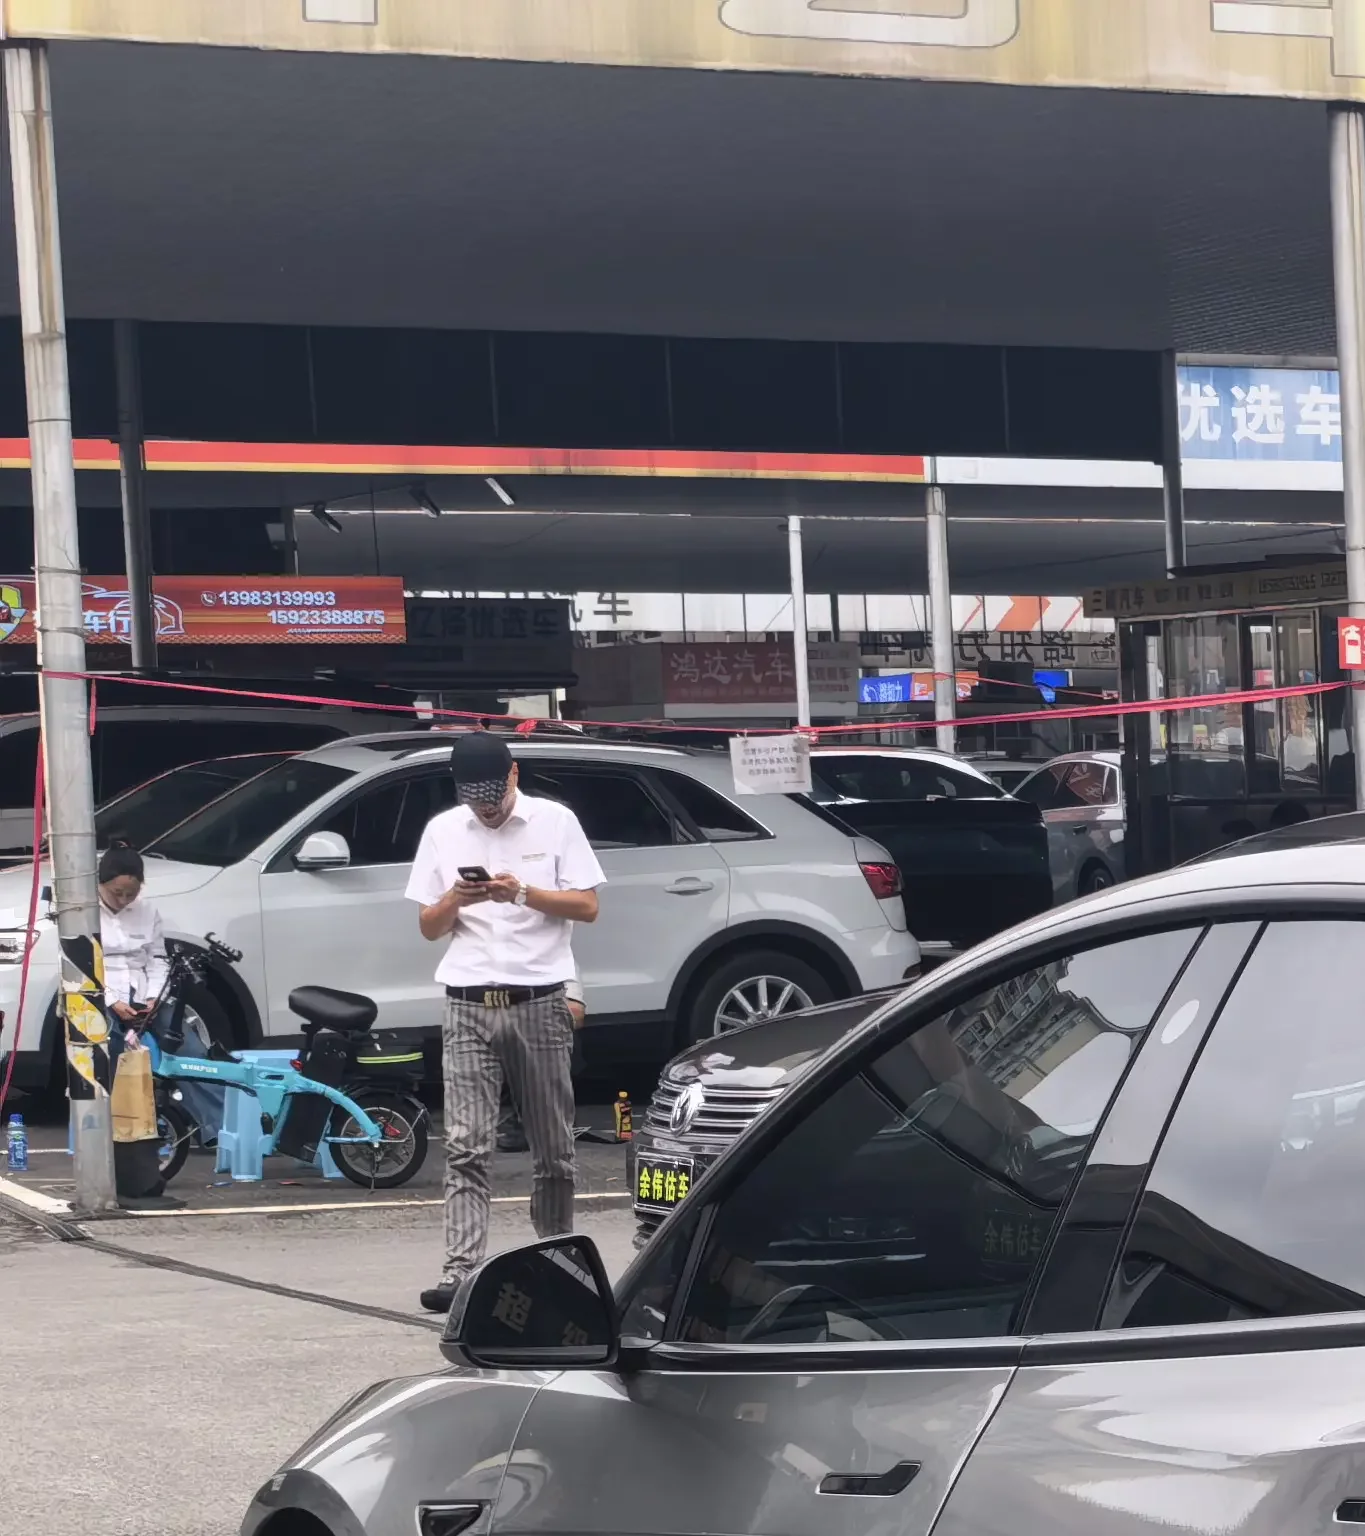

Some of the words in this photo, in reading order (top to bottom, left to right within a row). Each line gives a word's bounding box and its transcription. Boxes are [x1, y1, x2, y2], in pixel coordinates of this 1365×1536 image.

[219, 590, 335, 607] 13983139993
[267, 610, 386, 626] 15923388875
[670, 648, 794, 684] 鸿达汽车
